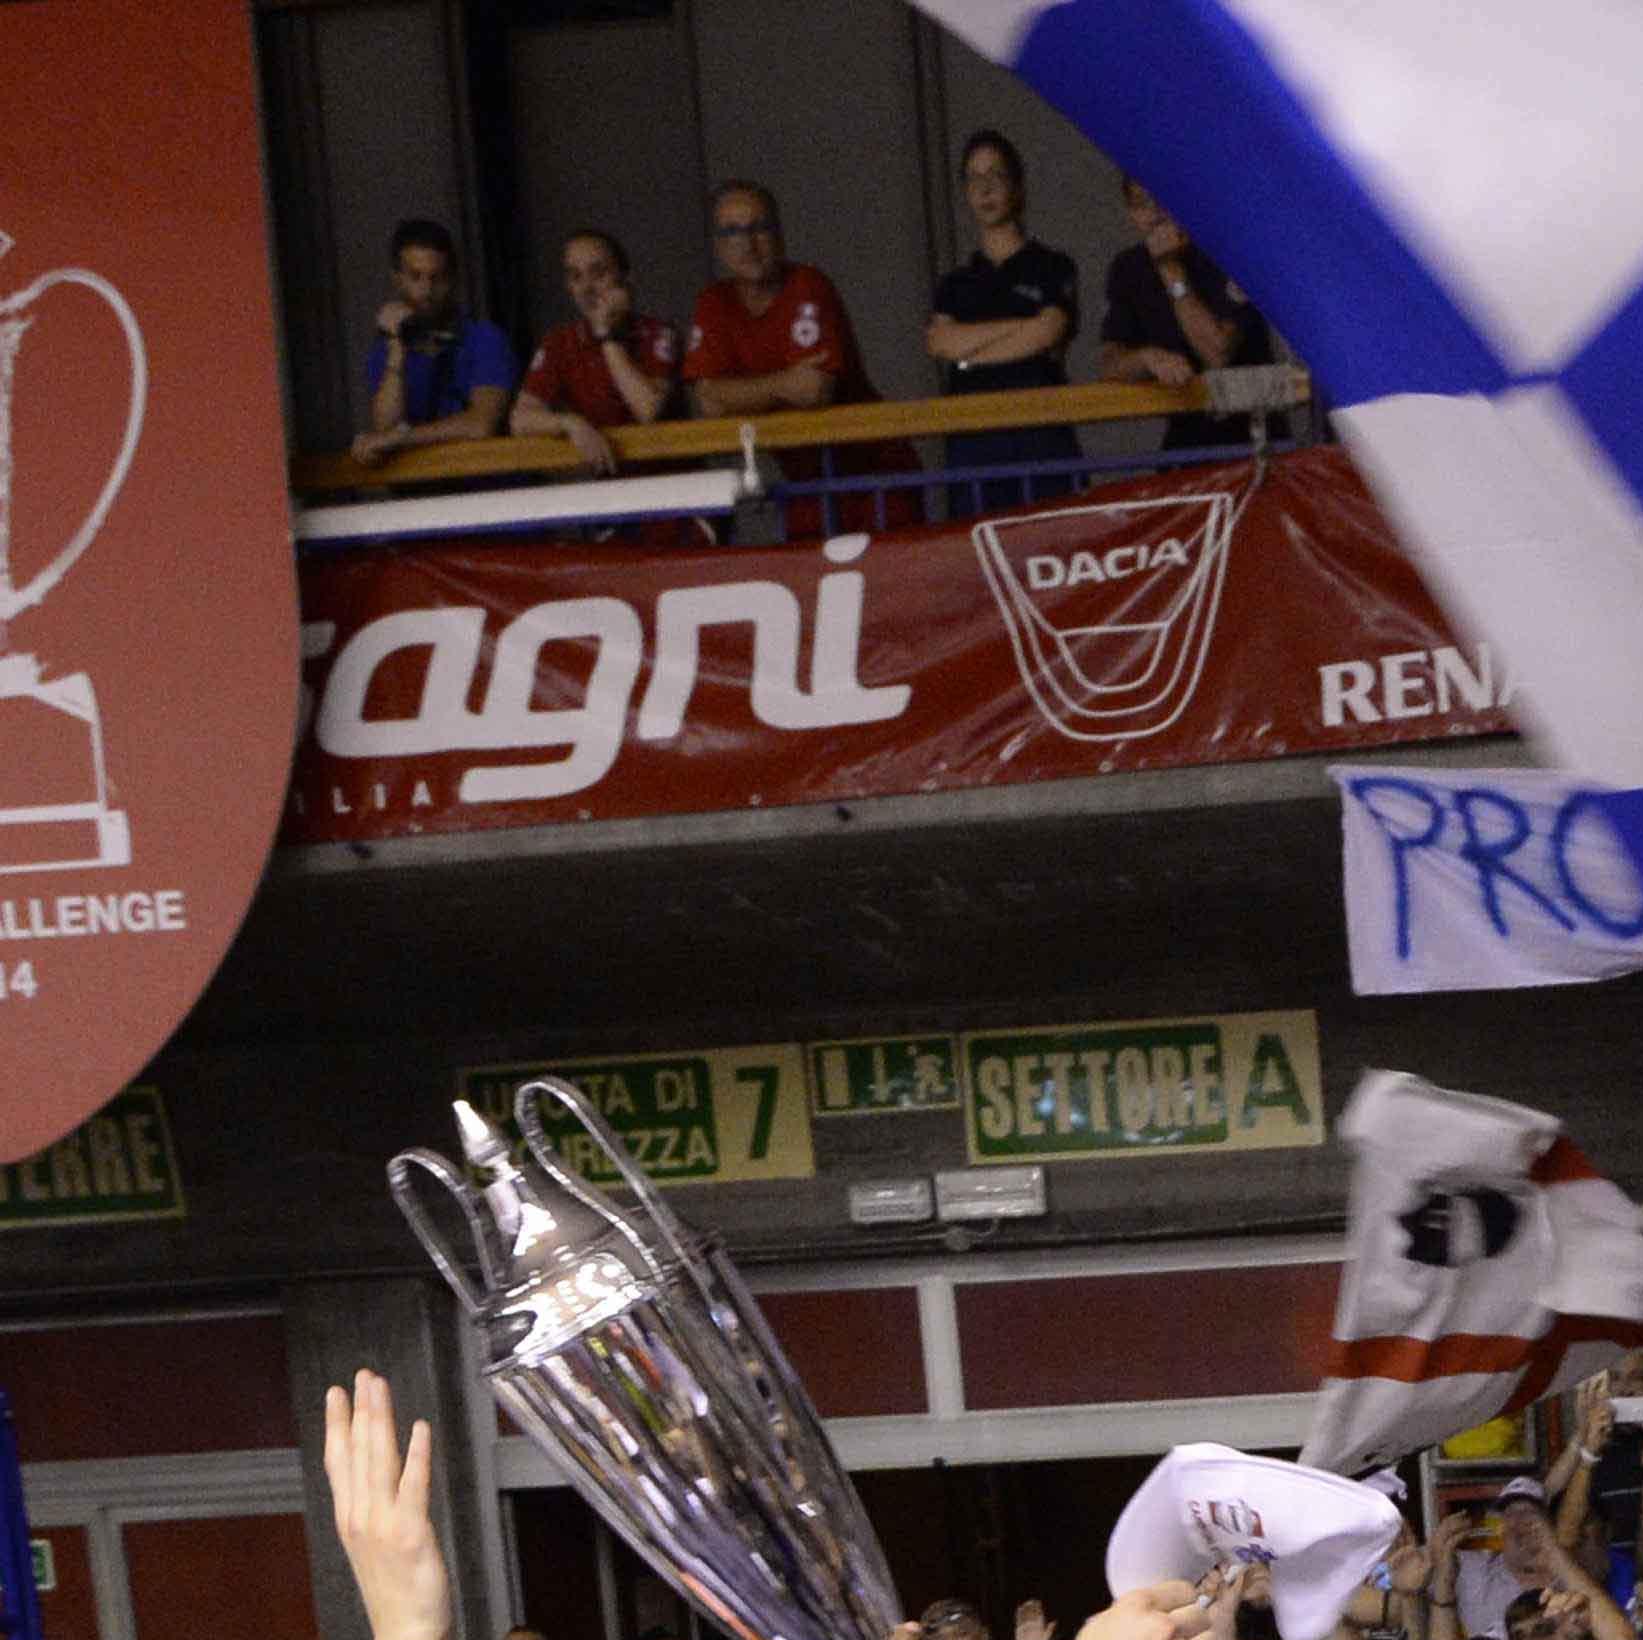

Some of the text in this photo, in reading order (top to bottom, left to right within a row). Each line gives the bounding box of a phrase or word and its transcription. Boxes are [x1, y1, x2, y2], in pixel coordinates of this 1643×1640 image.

[1026, 536, 1190, 590] DACIA
[0, 889, 188, 940] LLENGE
[654, 1067, 698, 1114] DI
[735, 1065, 780, 1160] 7
[976, 1032, 1312, 1139] SETTORE A
